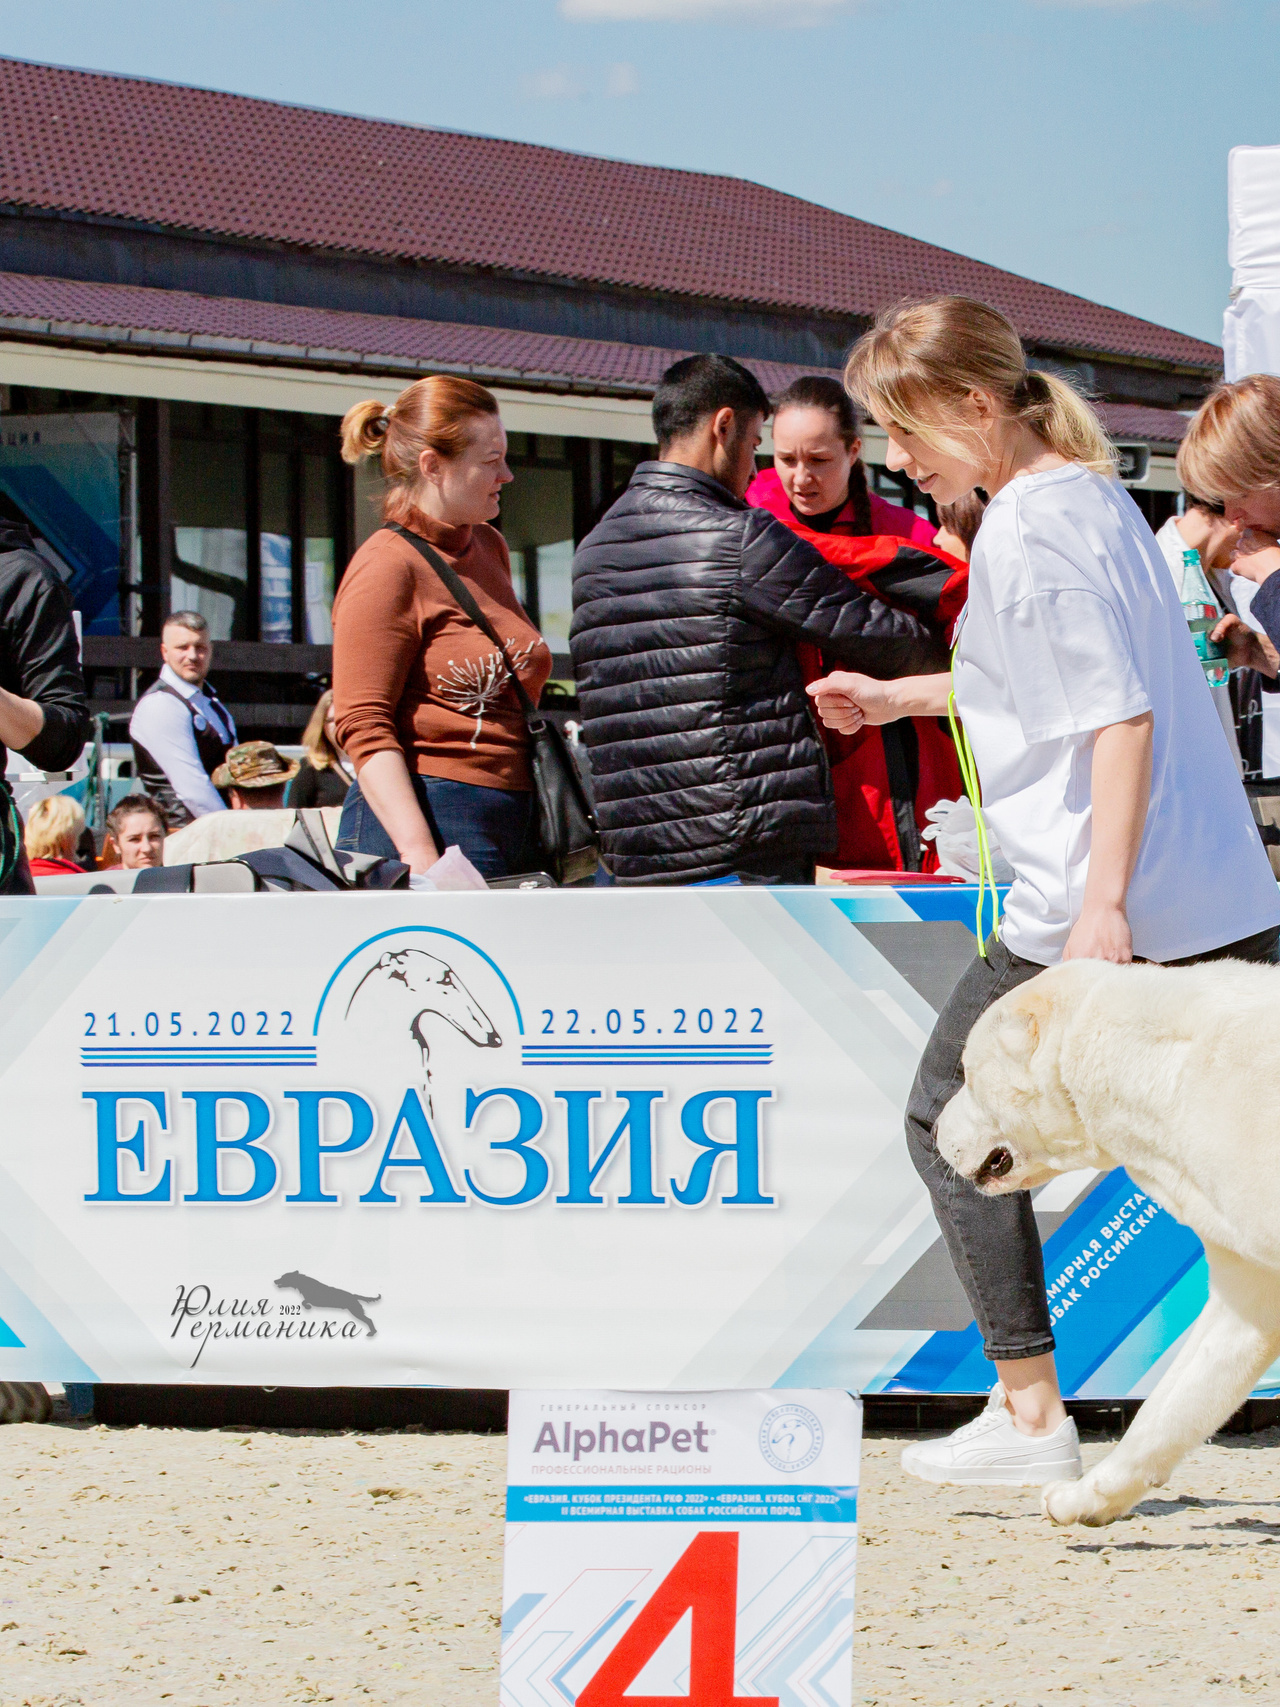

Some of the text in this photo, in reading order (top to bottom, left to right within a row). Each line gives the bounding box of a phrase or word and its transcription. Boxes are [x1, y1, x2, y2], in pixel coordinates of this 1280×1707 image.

[83, 1010, 295, 1038] 21.05.2022
[541, 1008, 766, 1036] 22.05.2022
[82, 1087, 776, 1205] ЕВРАЗИЯ
[1046, 1239, 1102, 1304] МИРНАЯ
[540, 1403, 707, 1412] ГЕНЕРАЛЬНЫЙ СПОНСОР
[531, 1465, 712, 1476] ПРОФЕССИОНАЛЬНЫЕ РАЦИОНЫ
[569, 1506, 625, 1516] ВСЕМИРНАЯ
[626, 1506, 674, 1516] ВЫСТАВКА
[675, 1506, 706, 1516] СОБАК
[707, 1505, 769, 1516] РОССИЙСКИХ
[769, 1506, 802, 1516] ПОРОД
[571, 1494, 602, 1504] КУБОК
[603, 1494, 662, 1505] ПРЕЗИДЕНТА
[663, 1494, 683, 1504] РКФ
[765, 1494, 796, 1504] КУБОК
[574, 1531, 780, 1707] 4
